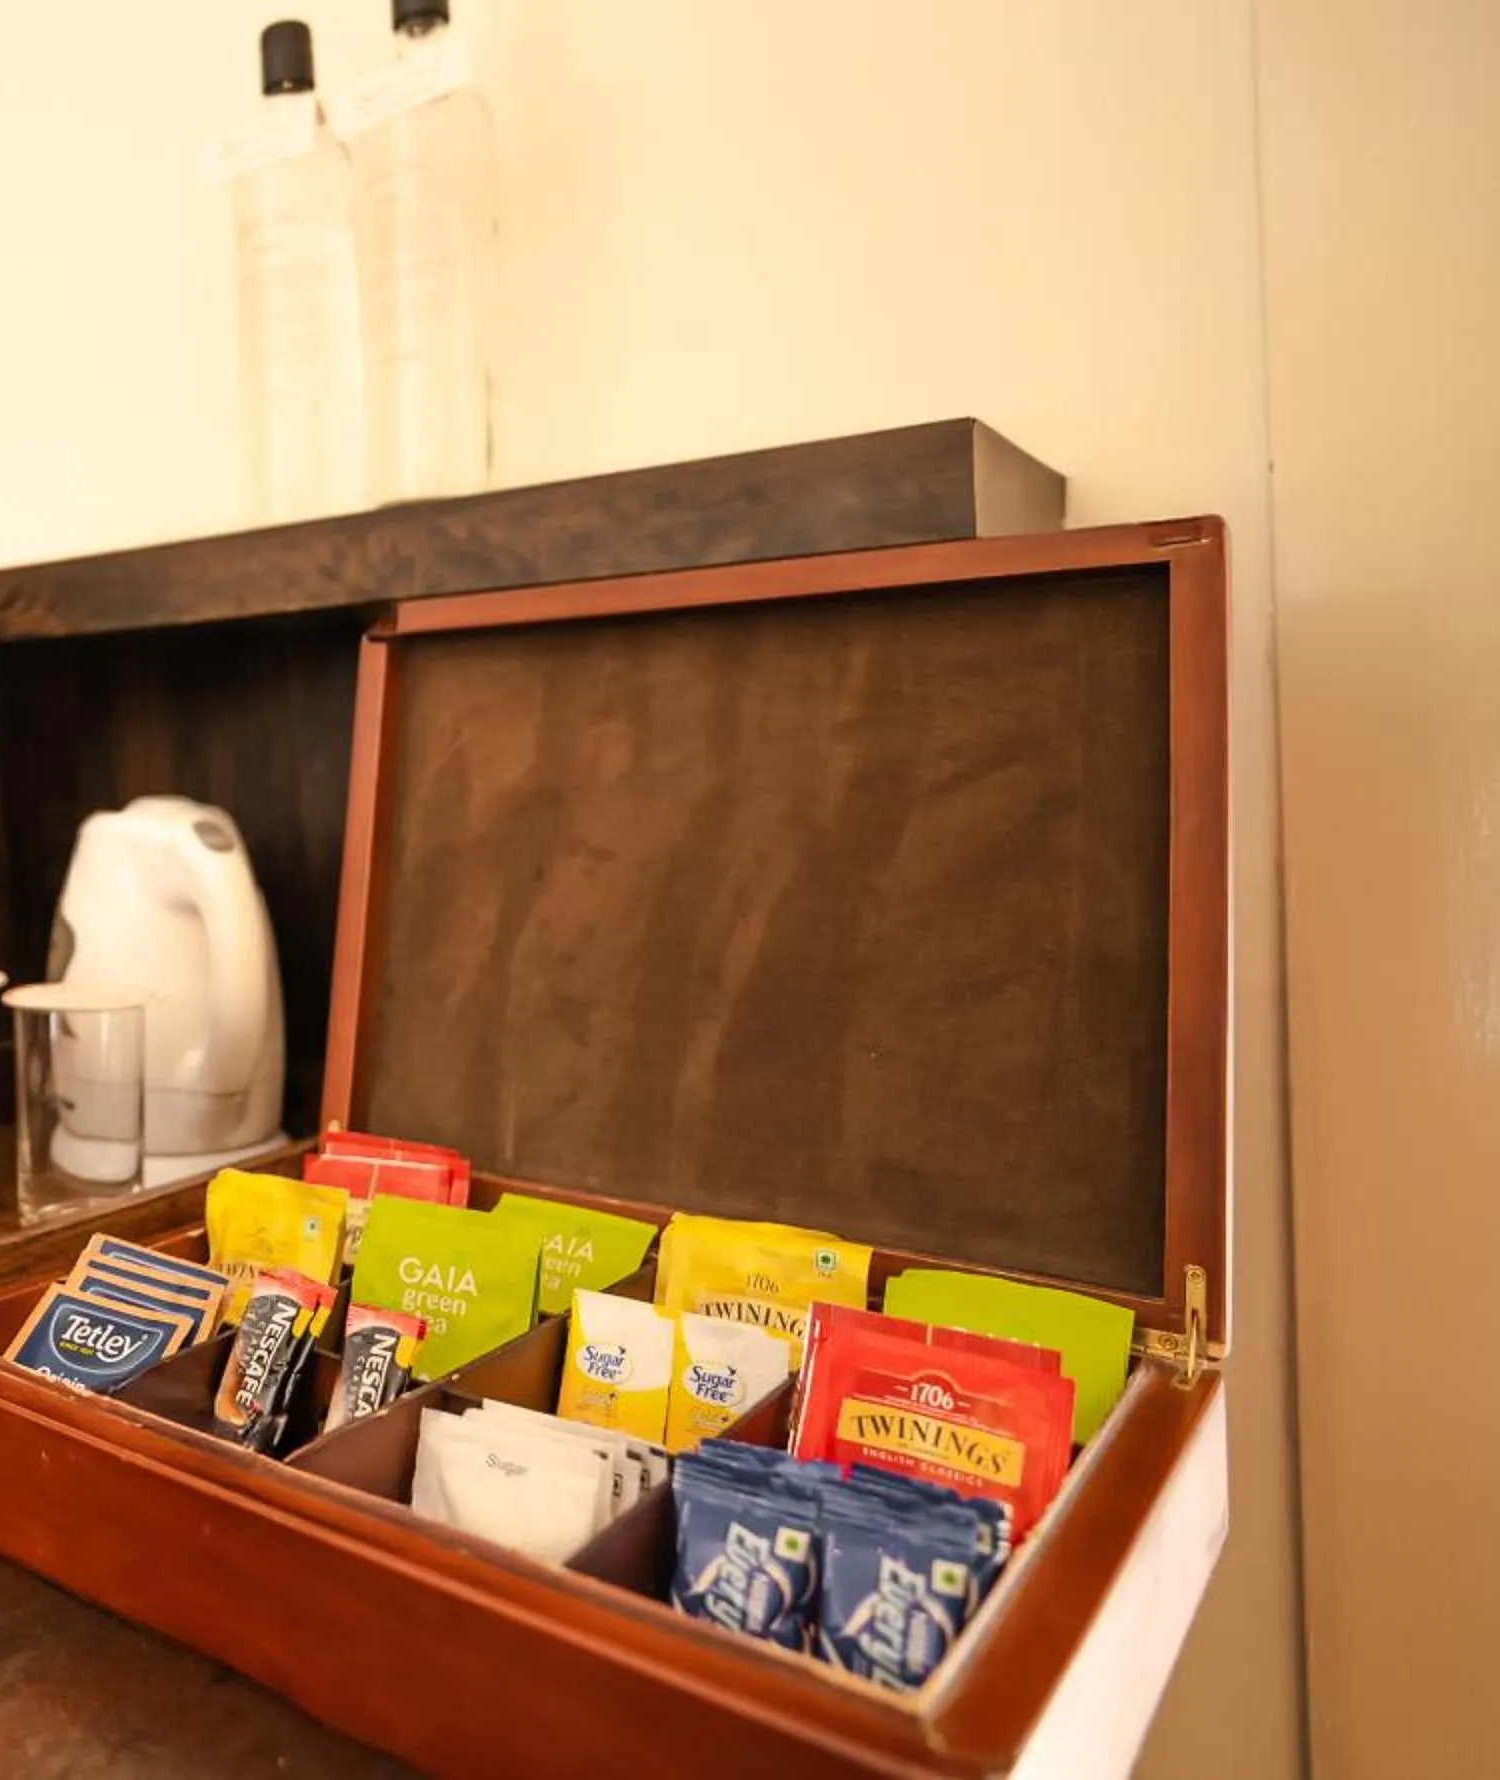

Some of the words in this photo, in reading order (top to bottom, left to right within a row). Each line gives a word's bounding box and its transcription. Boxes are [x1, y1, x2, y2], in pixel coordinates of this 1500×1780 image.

[543, 1234, 593, 1262] AIA
[399, 1256, 478, 1297] GAIA
[545, 1258, 581, 1278] een
[403, 1290, 467, 1317] green
[699, 1300, 805, 1339] TWINING
[61, 1315, 143, 1363] Tetley
[584, 1346, 624, 1369] Sugar
[588, 1362, 618, 1380] Free
[353, 1333, 397, 1418] NESCA
[690, 1365, 736, 1389] Sugar
[696, 1383, 728, 1402] Free
[911, 1383, 955, 1410] 1706
[851, 1414, 1009, 1475] TWININGS
[484, 1452, 529, 1477] Sugar
